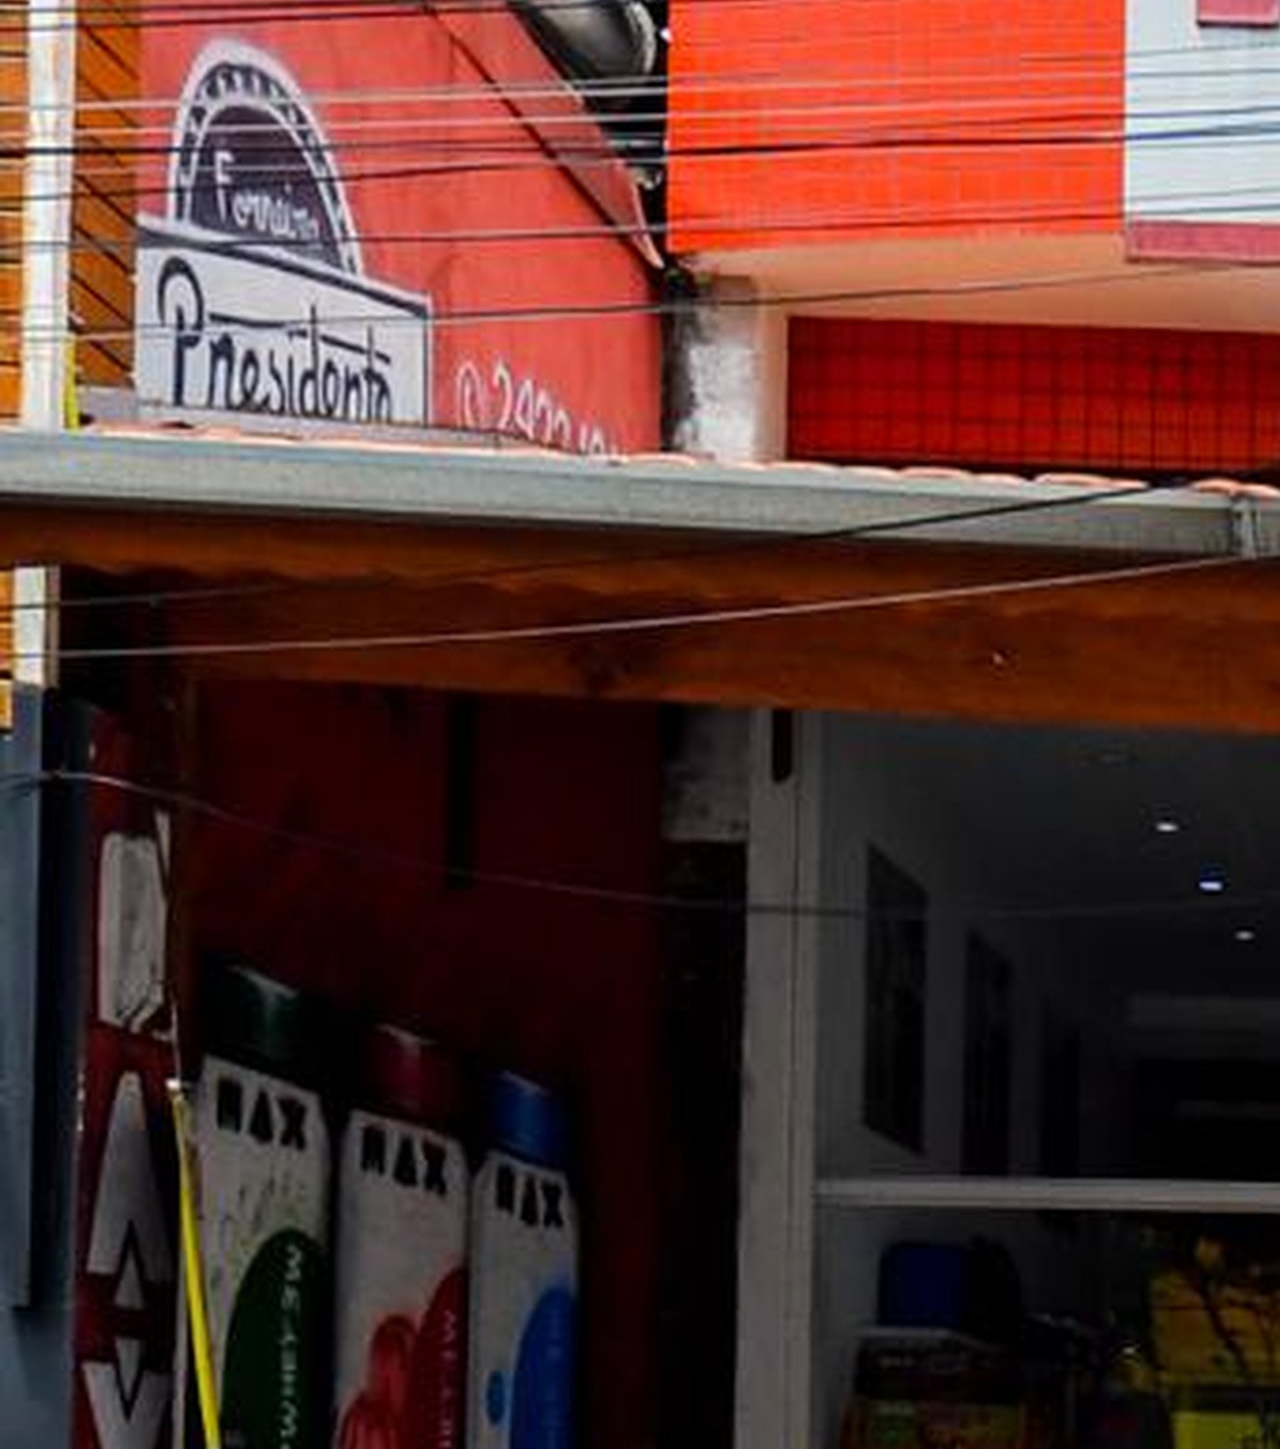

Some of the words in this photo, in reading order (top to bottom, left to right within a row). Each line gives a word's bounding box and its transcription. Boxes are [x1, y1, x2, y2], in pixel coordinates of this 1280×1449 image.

[216, 1076, 307, 1151] MAX
[359, 1122, 448, 1196] MAX
[494, 1162, 564, 1229] MAX
